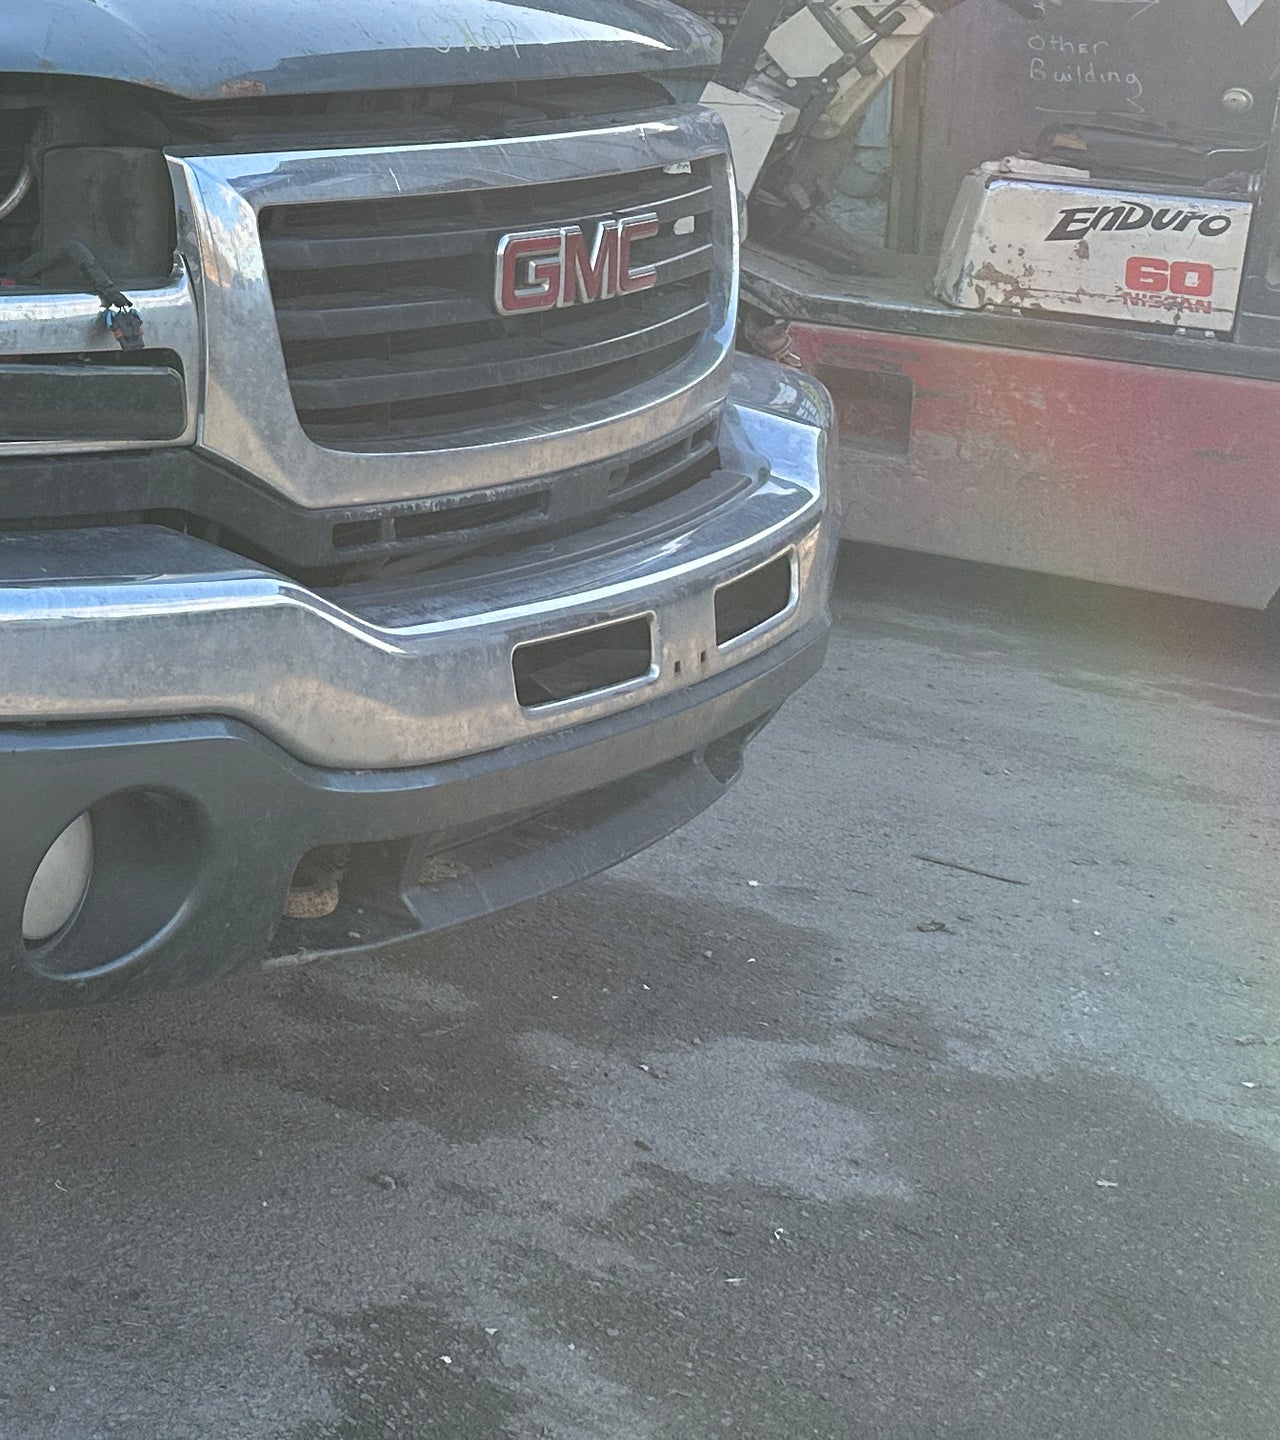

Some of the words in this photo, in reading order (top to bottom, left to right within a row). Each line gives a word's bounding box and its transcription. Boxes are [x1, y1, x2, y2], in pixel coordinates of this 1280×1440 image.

[1029, 57, 1143, 96] Building
[494, 211, 659, 317] GMC
[1124, 256, 1215, 297] 60
[1121, 291, 1213, 315] NISSAN
